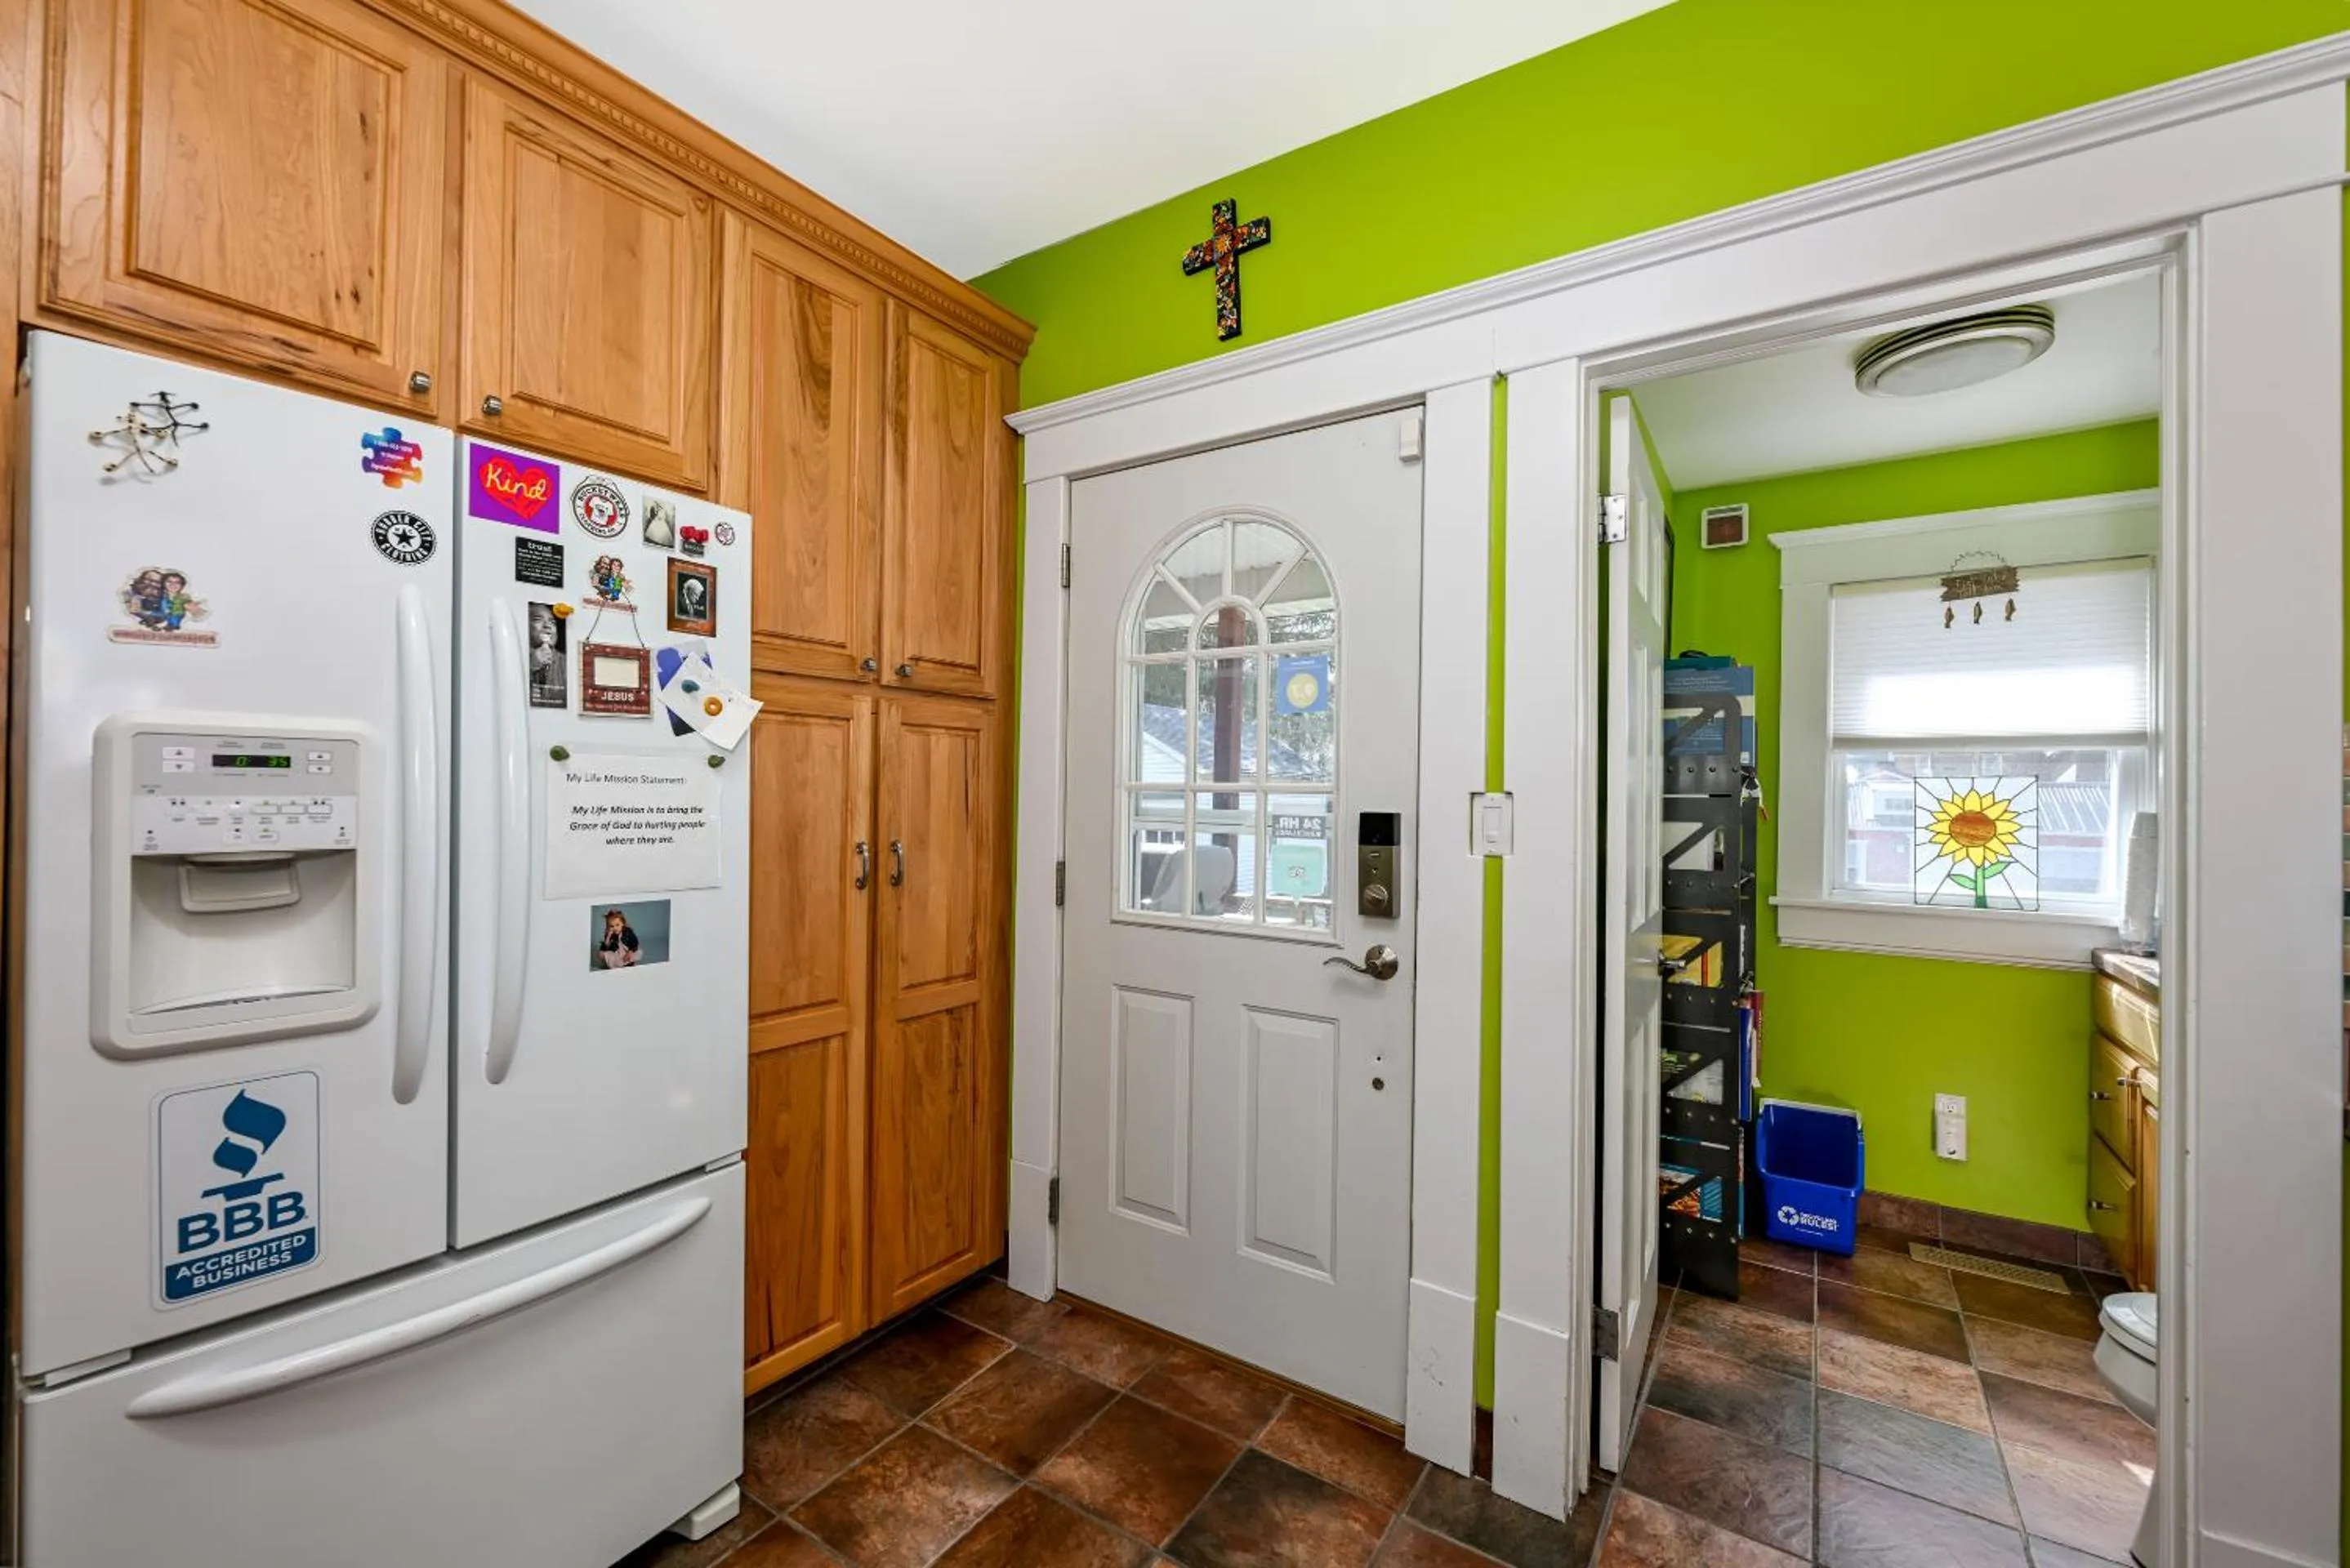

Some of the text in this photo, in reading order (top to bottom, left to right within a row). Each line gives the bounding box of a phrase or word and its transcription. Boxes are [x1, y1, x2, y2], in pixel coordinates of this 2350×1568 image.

[485, 463, 547, 501] Kind
[601, 692, 635, 702] JESUS
[565, 773, 582, 784] My
[584, 773, 602, 783] Life
[604, 774, 638, 784] Mission
[572, 805, 703, 817] My Life Mission is to bring the
[569, 820, 706, 831] Grace of God to hurting people
[605, 835, 635, 845] where
[637, 836, 656, 845] they
[177, 1191, 307, 1254] BBB
[176, 1235, 307, 1281] ACCREDITED
[193, 1251, 292, 1289] BUSINESS
